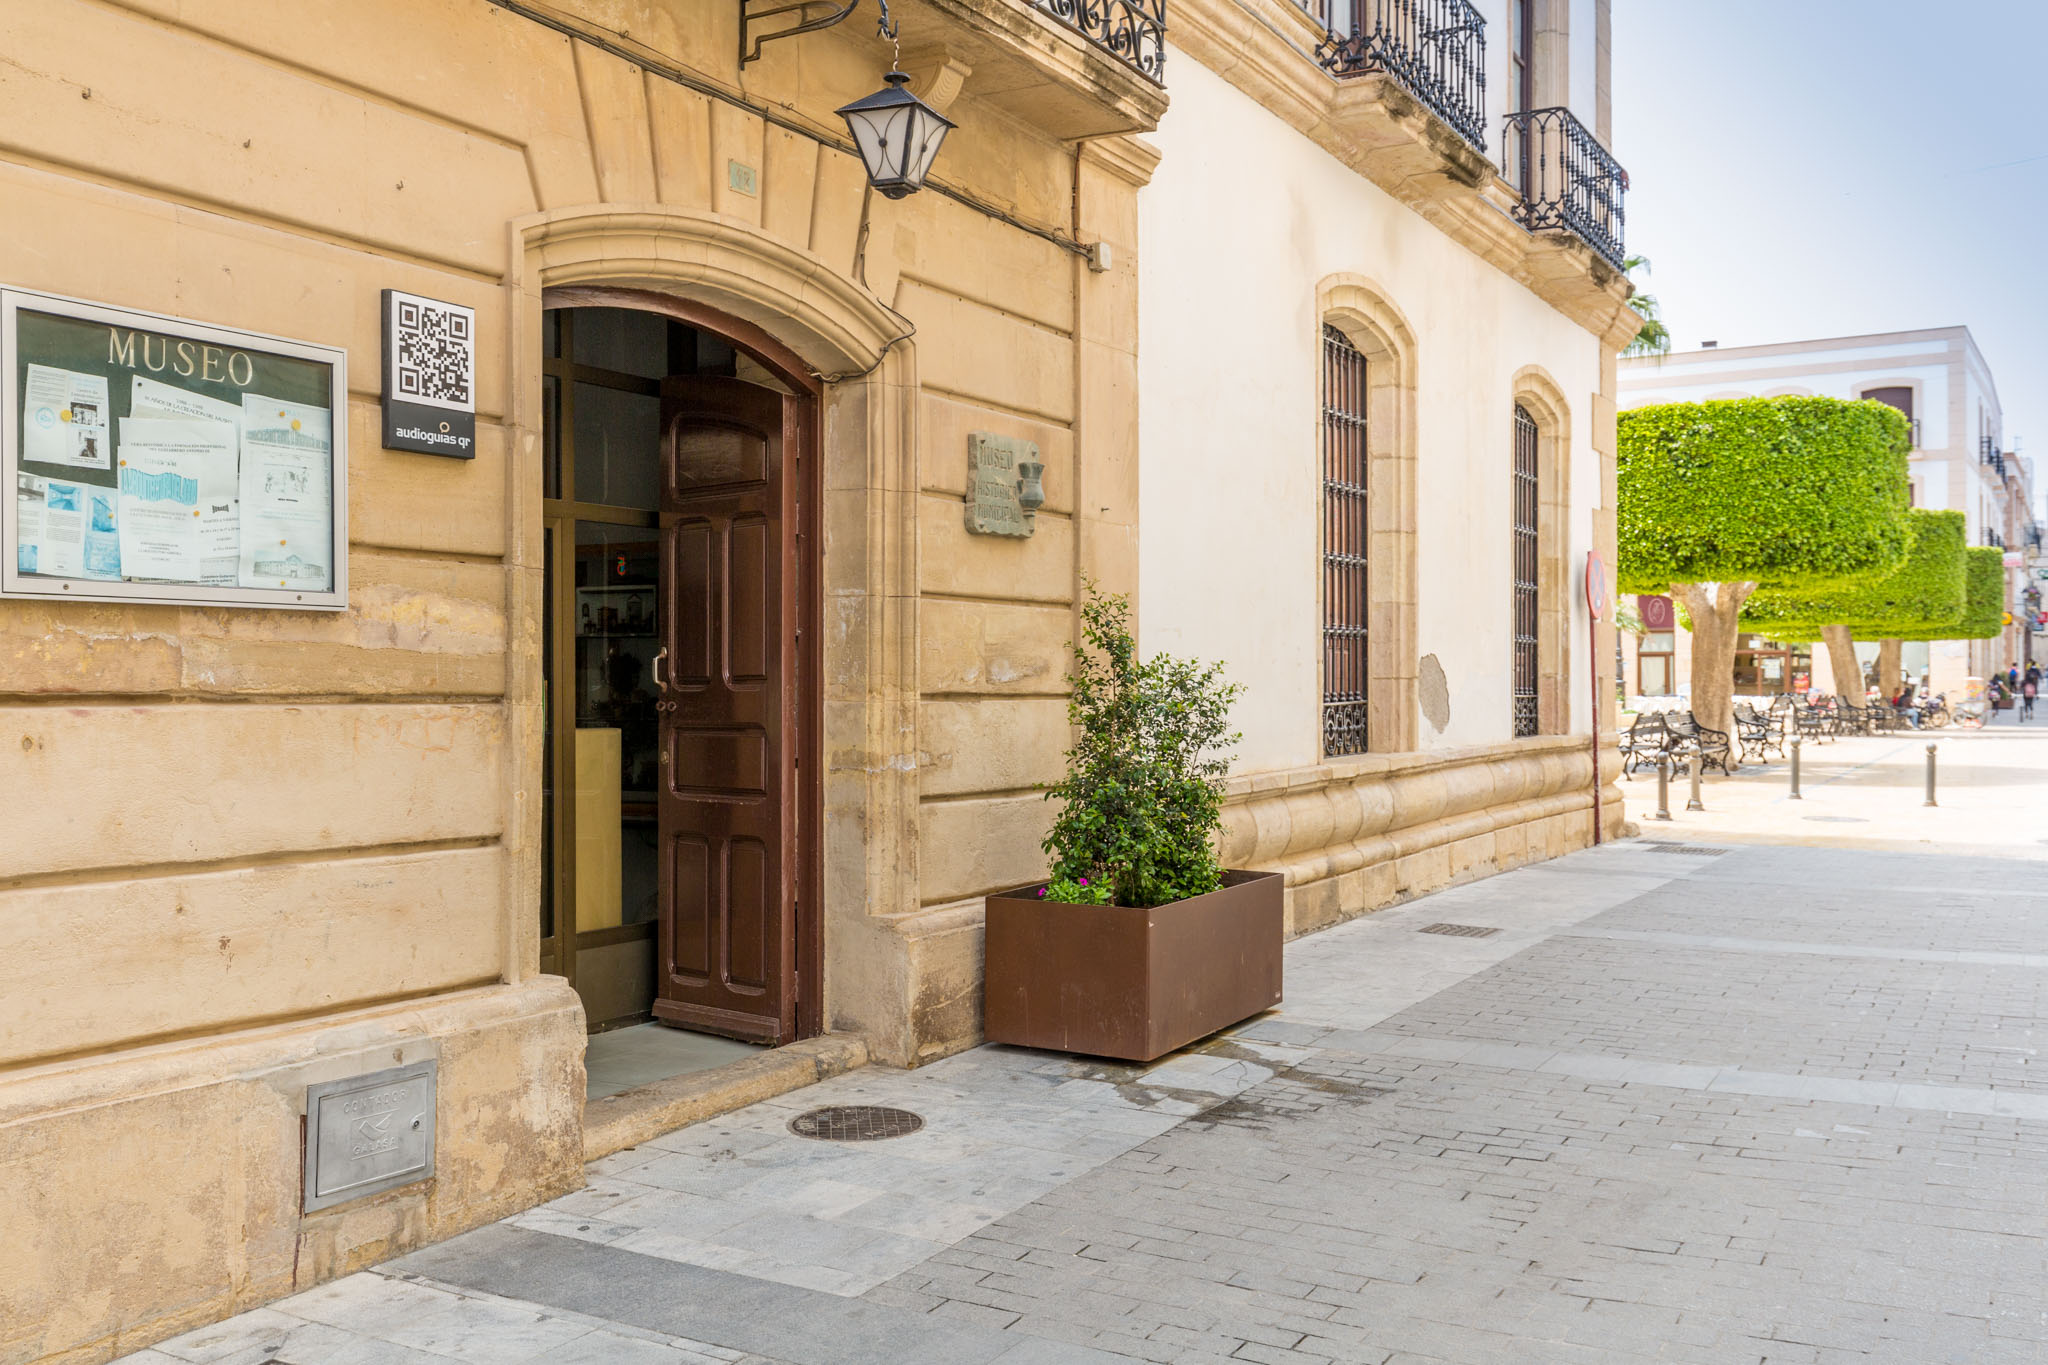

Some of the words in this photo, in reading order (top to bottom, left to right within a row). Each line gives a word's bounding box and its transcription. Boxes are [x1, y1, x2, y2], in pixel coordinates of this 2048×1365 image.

[108, 327, 254, 387] MUSEO
[396, 425, 457, 445] audioguias
[458, 436, 471, 449] qr
[979, 446, 1013, 470] MUSEO
[343, 1089, 408, 1114] CONTADOR
